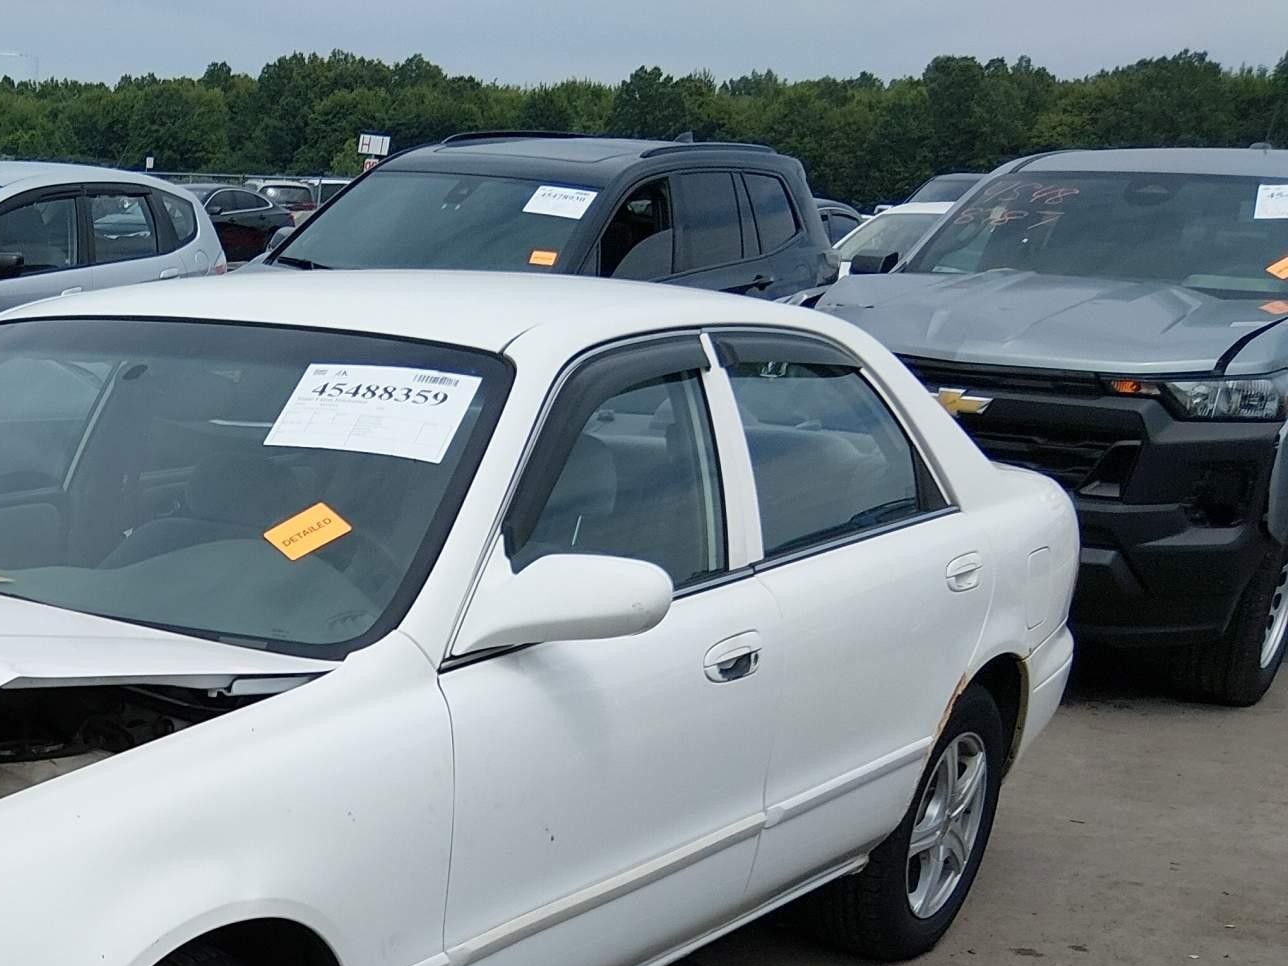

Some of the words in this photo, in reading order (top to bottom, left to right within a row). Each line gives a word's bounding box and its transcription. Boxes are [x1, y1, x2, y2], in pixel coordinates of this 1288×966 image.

[360, 135, 372, 152] H
[311, 381, 449, 407] 45488359
[281, 517, 333, 548] DETAILED
